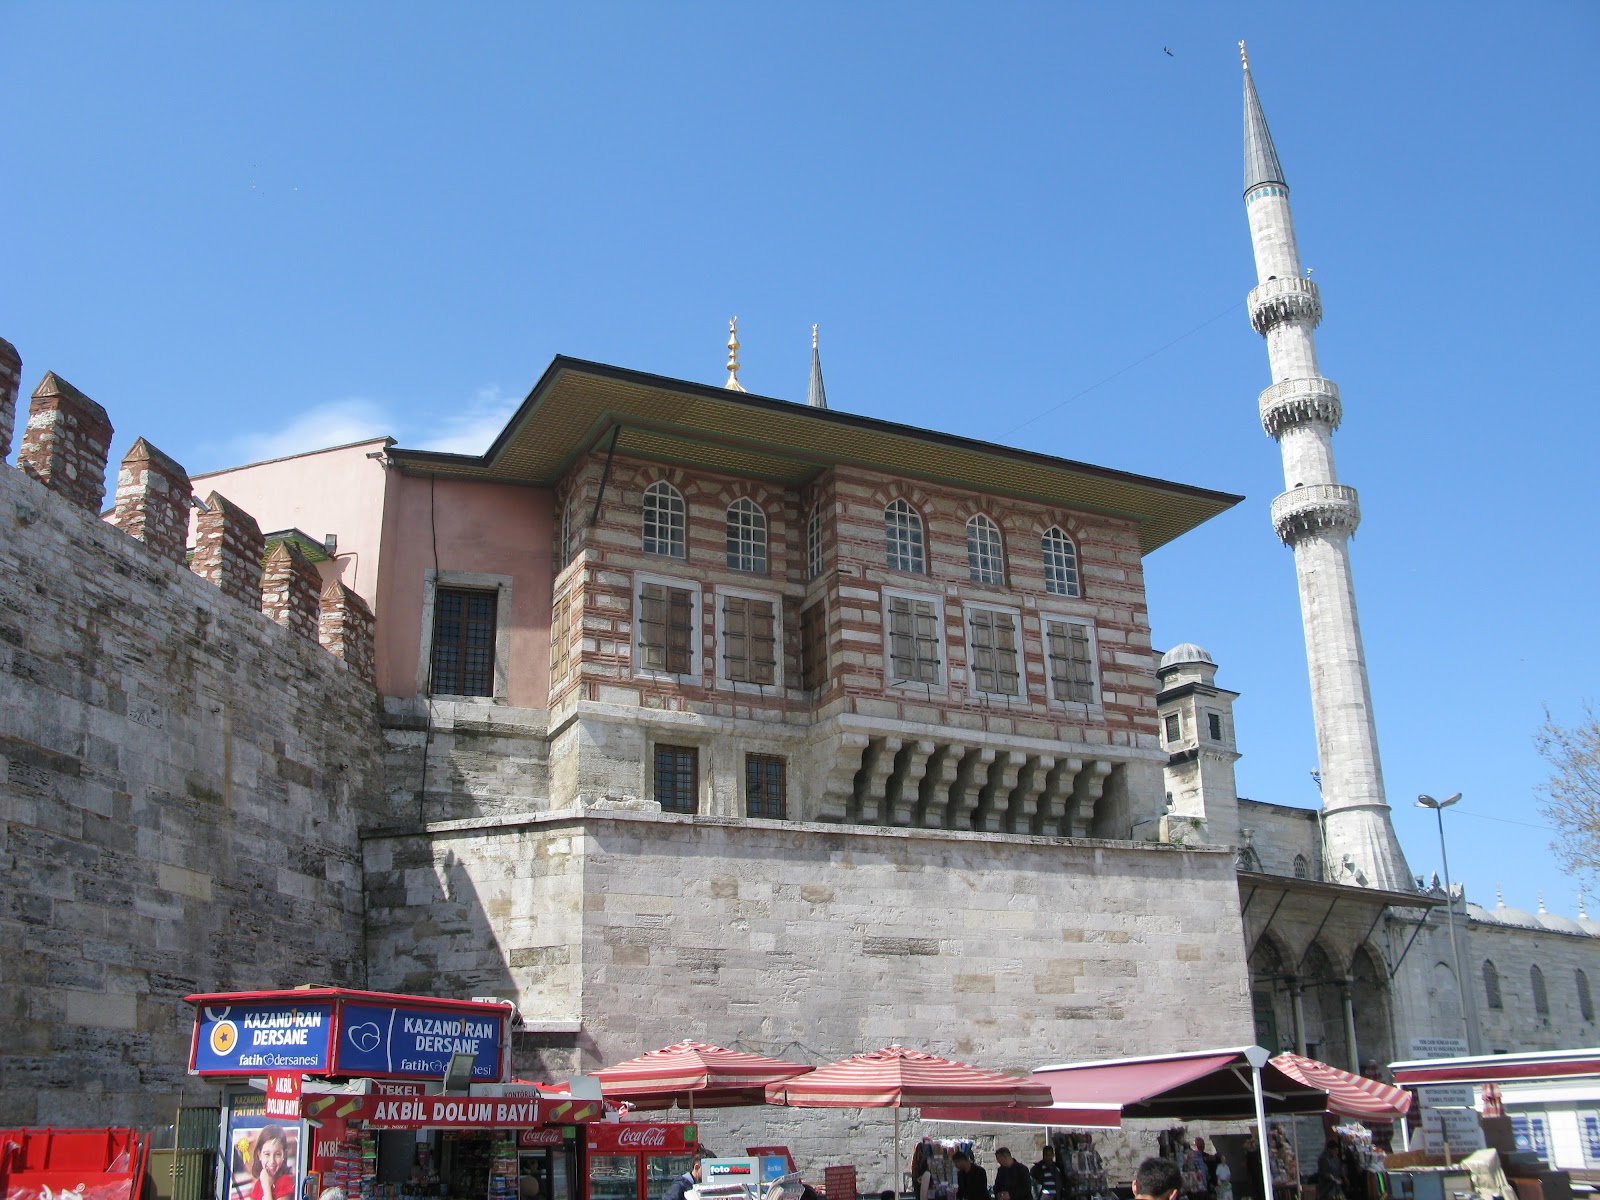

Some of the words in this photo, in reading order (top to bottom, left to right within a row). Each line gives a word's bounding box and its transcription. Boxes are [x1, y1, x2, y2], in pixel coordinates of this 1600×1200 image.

[252, 1029, 309, 1046] DERSANE
[415, 1035, 480, 1055] DERSANE
[239, 1054, 263, 1066] fatih
[273, 1054, 319, 1066] dersanesi
[400, 1058, 429, 1071] fatih
[275, 1074, 293, 1094] AKBİL
[377, 1085, 421, 1096] TEKEL
[266, 1098, 285, 1115] DOLUM
[374, 1098, 427, 1121] AKBİL
[432, 1103, 493, 1122] DOLUM
[496, 1099, 540, 1122] BAYİİ
